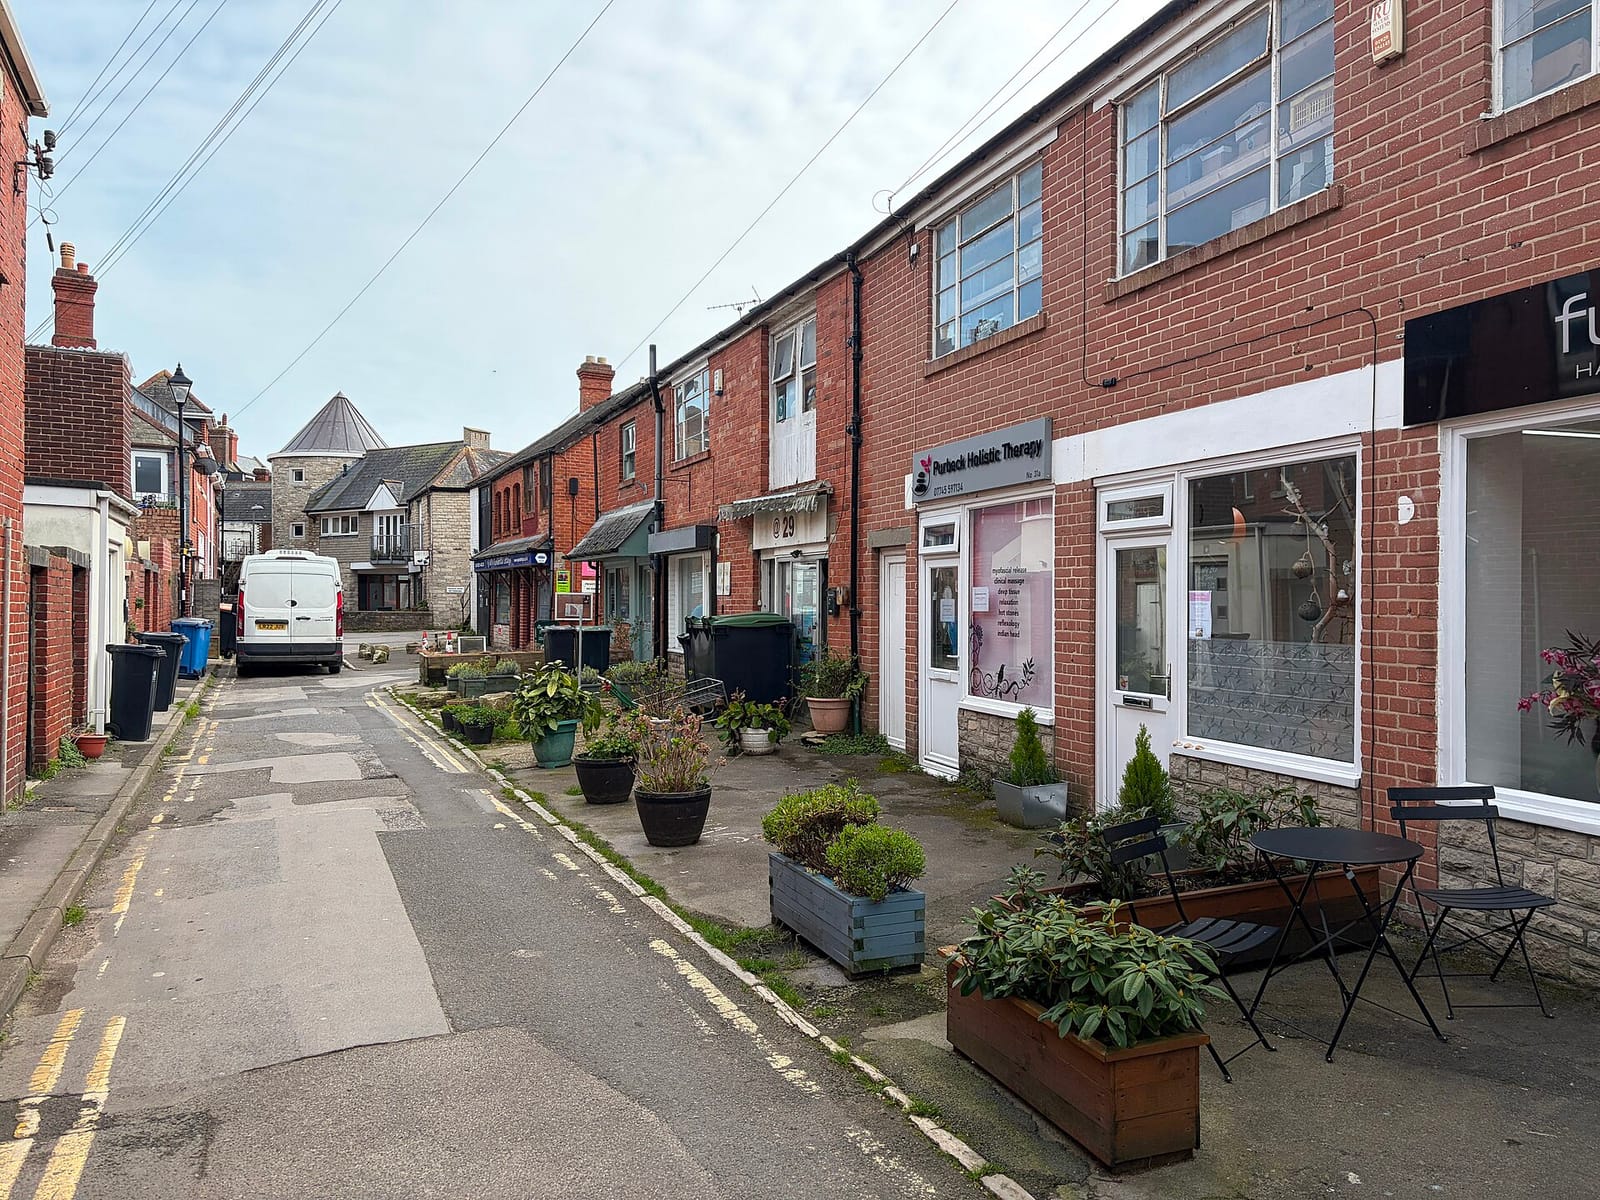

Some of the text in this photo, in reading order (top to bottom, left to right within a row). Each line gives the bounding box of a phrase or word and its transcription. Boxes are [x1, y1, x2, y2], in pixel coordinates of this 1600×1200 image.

[933, 439, 1042, 476] Purbeck Holistic Therapy
[783, 515, 794, 538] 29
[1008, 578, 1025, 586] massage
[997, 618, 1020, 629] reflexology
